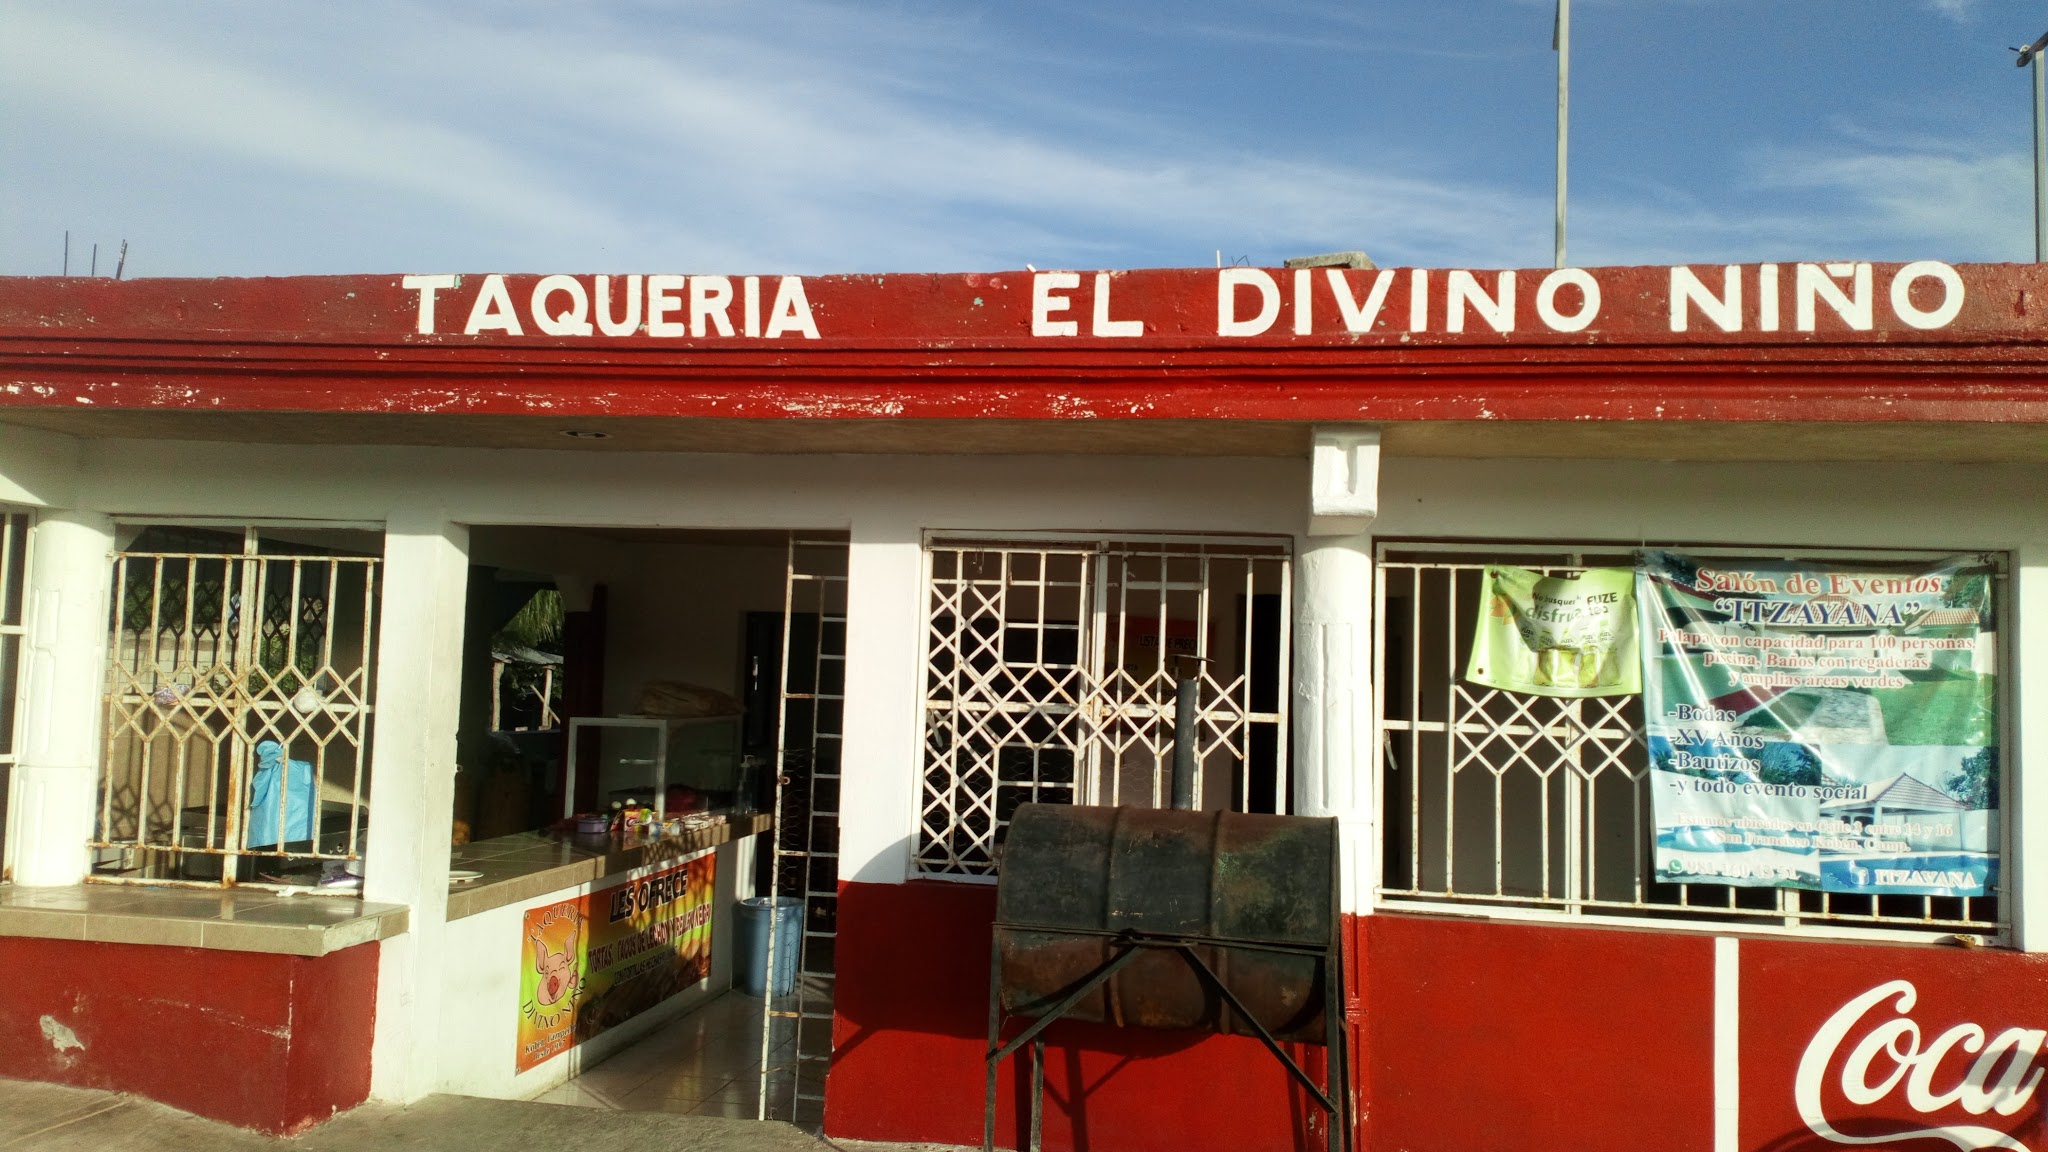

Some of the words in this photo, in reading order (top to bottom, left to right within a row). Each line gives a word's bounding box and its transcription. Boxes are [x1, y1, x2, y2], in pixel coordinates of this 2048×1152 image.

[402, 273, 822, 339] TAQUERIA
[1032, 271, 1144, 337] EL
[1217, 268, 1601, 336] DIVINO
[1669, 260, 1966, 333] NIÑO
[1696, 567, 1777, 594] Salón
[1785, 573, 1820, 595] de
[1828, 573, 1941, 595] Eventos
[1586, 592, 1618, 605] FUZE
[1713, 633, 1740, 646] con
[1744, 634, 1824, 650] capacidad
[1828, 637, 1863, 653] para
[1869, 635, 1897, 649] 100
[1902, 637, 1976, 653] personas,
[1703, 650, 1762, 669] piscina,
[1766, 652, 1815, 667] Baños
[1819, 656, 1845, 668] con
[1850, 655, 1929, 671] regaderas
[1728, 673, 1739, 686] y
[1742, 671, 1801, 688] amplias
[1806, 673, 1848, 687] áreas
[1852, 674, 1906, 688] verdes
[1713, 729, 1764, 749] Años
[1694, 779, 1736, 795] todo
[1743, 784, 1807, 798] evento
[1813, 784, 1868, 800] social
[1736, 815, 1793, 831] ubicados
[1796, 822, 1813, 832] en
[1818, 820, 1851, 834] Calle
[1865, 822, 1902, 835] entre
[1923, 825, 1933, 838] y
[1936, 824, 1953, 836] 16
[1715, 831, 1742, 844] San
[1746, 832, 1810, 847] Francisco
[1864, 838, 1911, 852] Camp.
[1875, 868, 1977, 888] ITZAYANA
[609, 886, 635, 923] LES
[638, 869, 689, 913] OFRECE
[522, 1000, 560, 1029] DIVINO
[1795, 980, 2048, 1140] Coca
